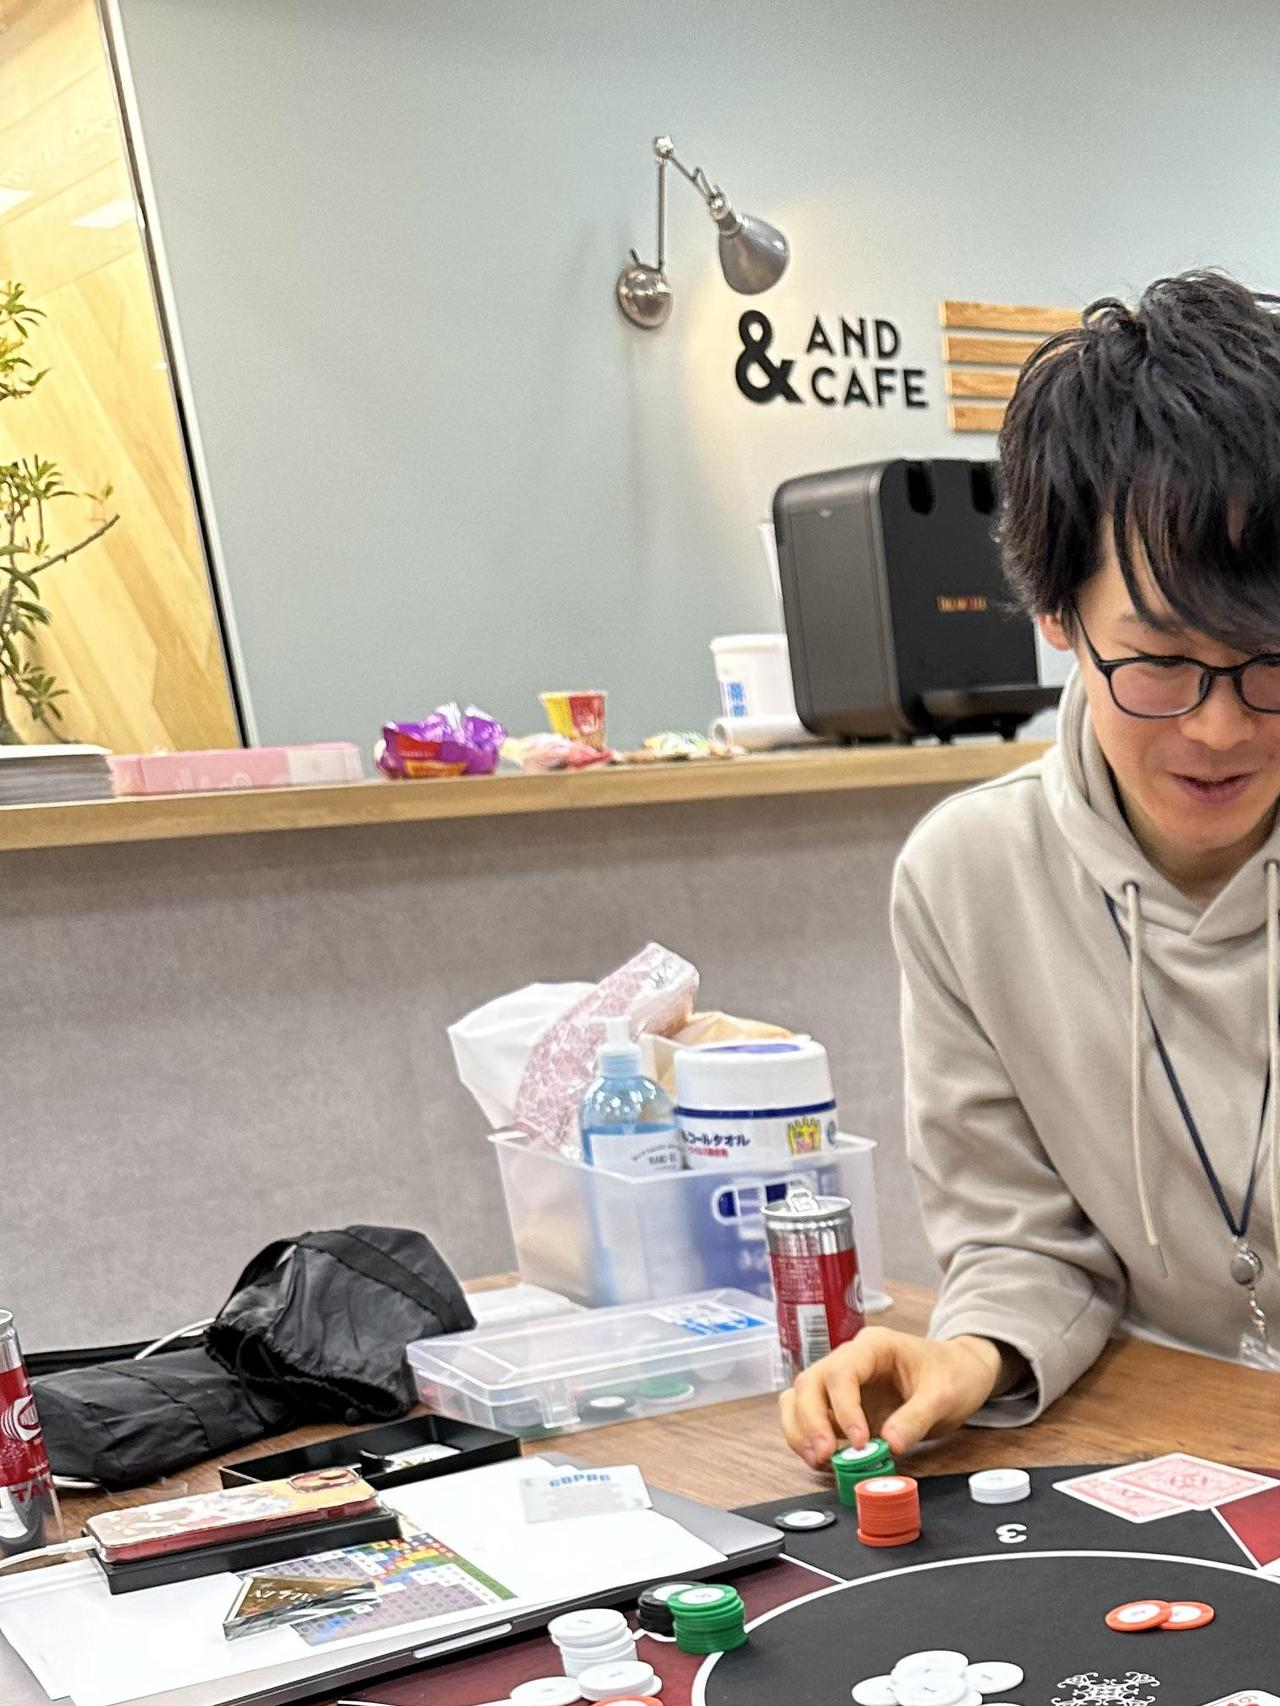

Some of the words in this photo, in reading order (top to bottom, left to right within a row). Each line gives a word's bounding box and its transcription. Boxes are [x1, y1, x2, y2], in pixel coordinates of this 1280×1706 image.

[735, 310, 803, 404] &
[806, 316, 900, 360] AND
[811, 366, 928, 408] CAFE
[995, 1523, 1027, 1544] 3
